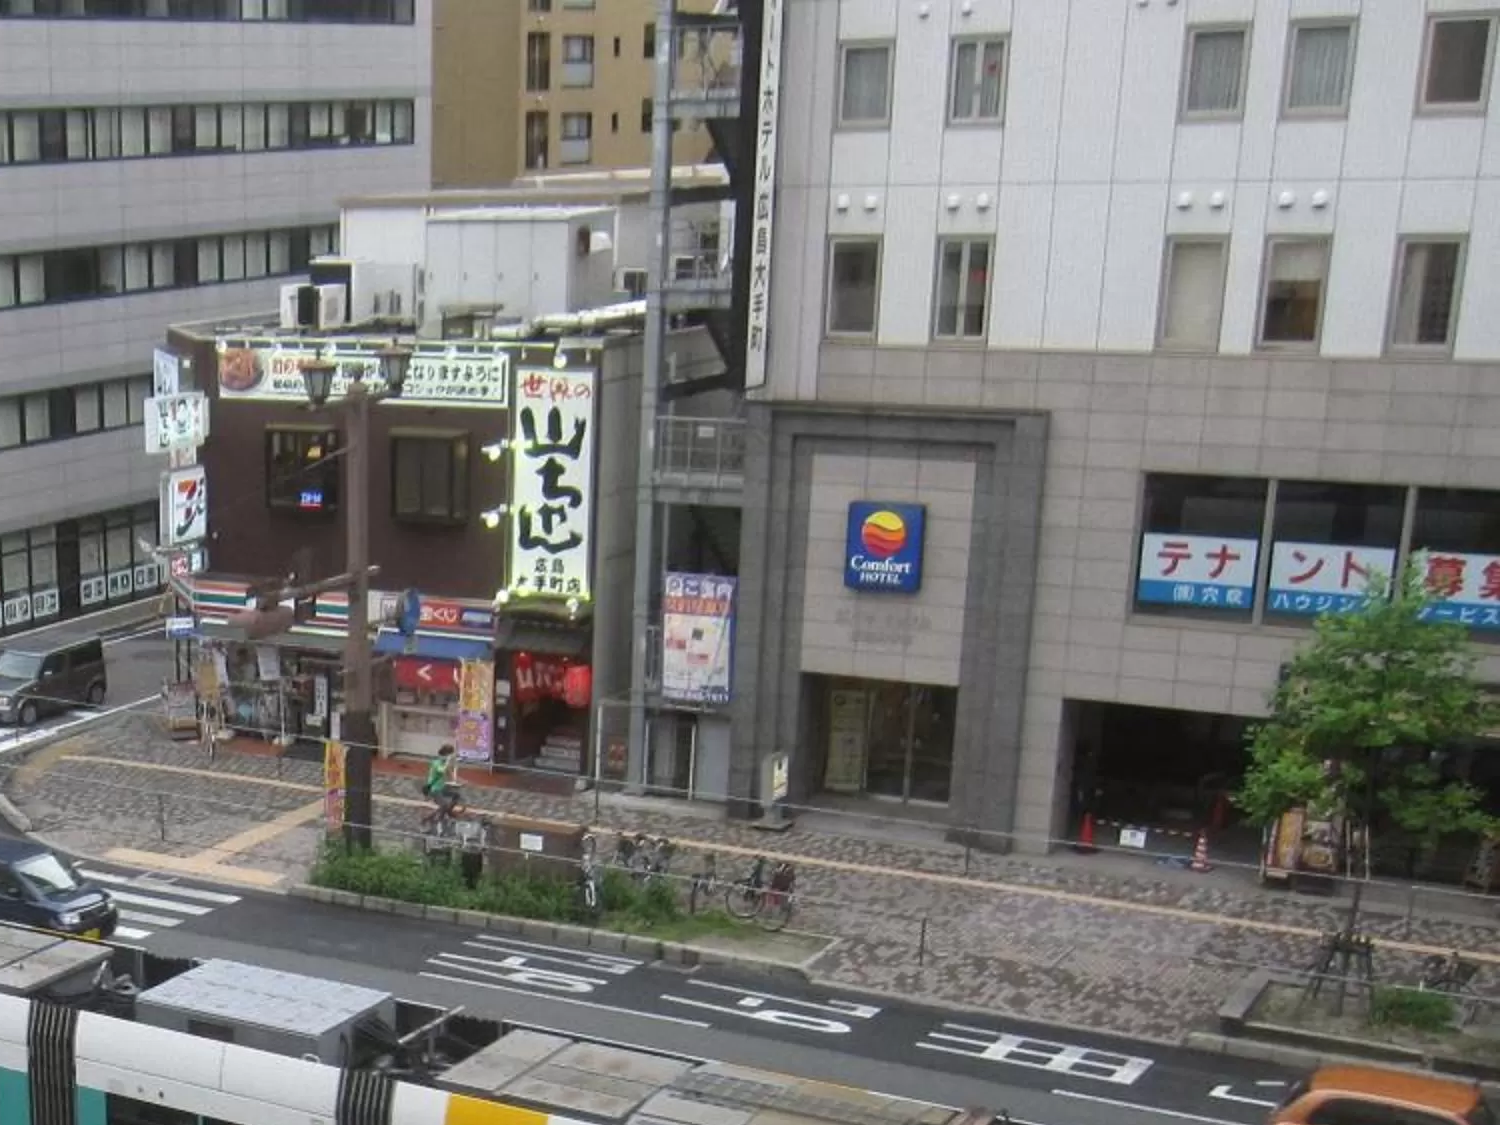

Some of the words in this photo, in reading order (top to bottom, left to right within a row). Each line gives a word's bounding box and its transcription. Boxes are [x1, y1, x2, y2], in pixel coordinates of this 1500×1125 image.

[521, 371, 591, 402] 世界の
[519, 405, 588, 555] 山ちゃん
[534, 557, 565, 575] 広島
[851, 555, 912, 574] Comfort
[516, 576, 581, 593] 大手町店
[860, 571, 902, 585] HOTEL
